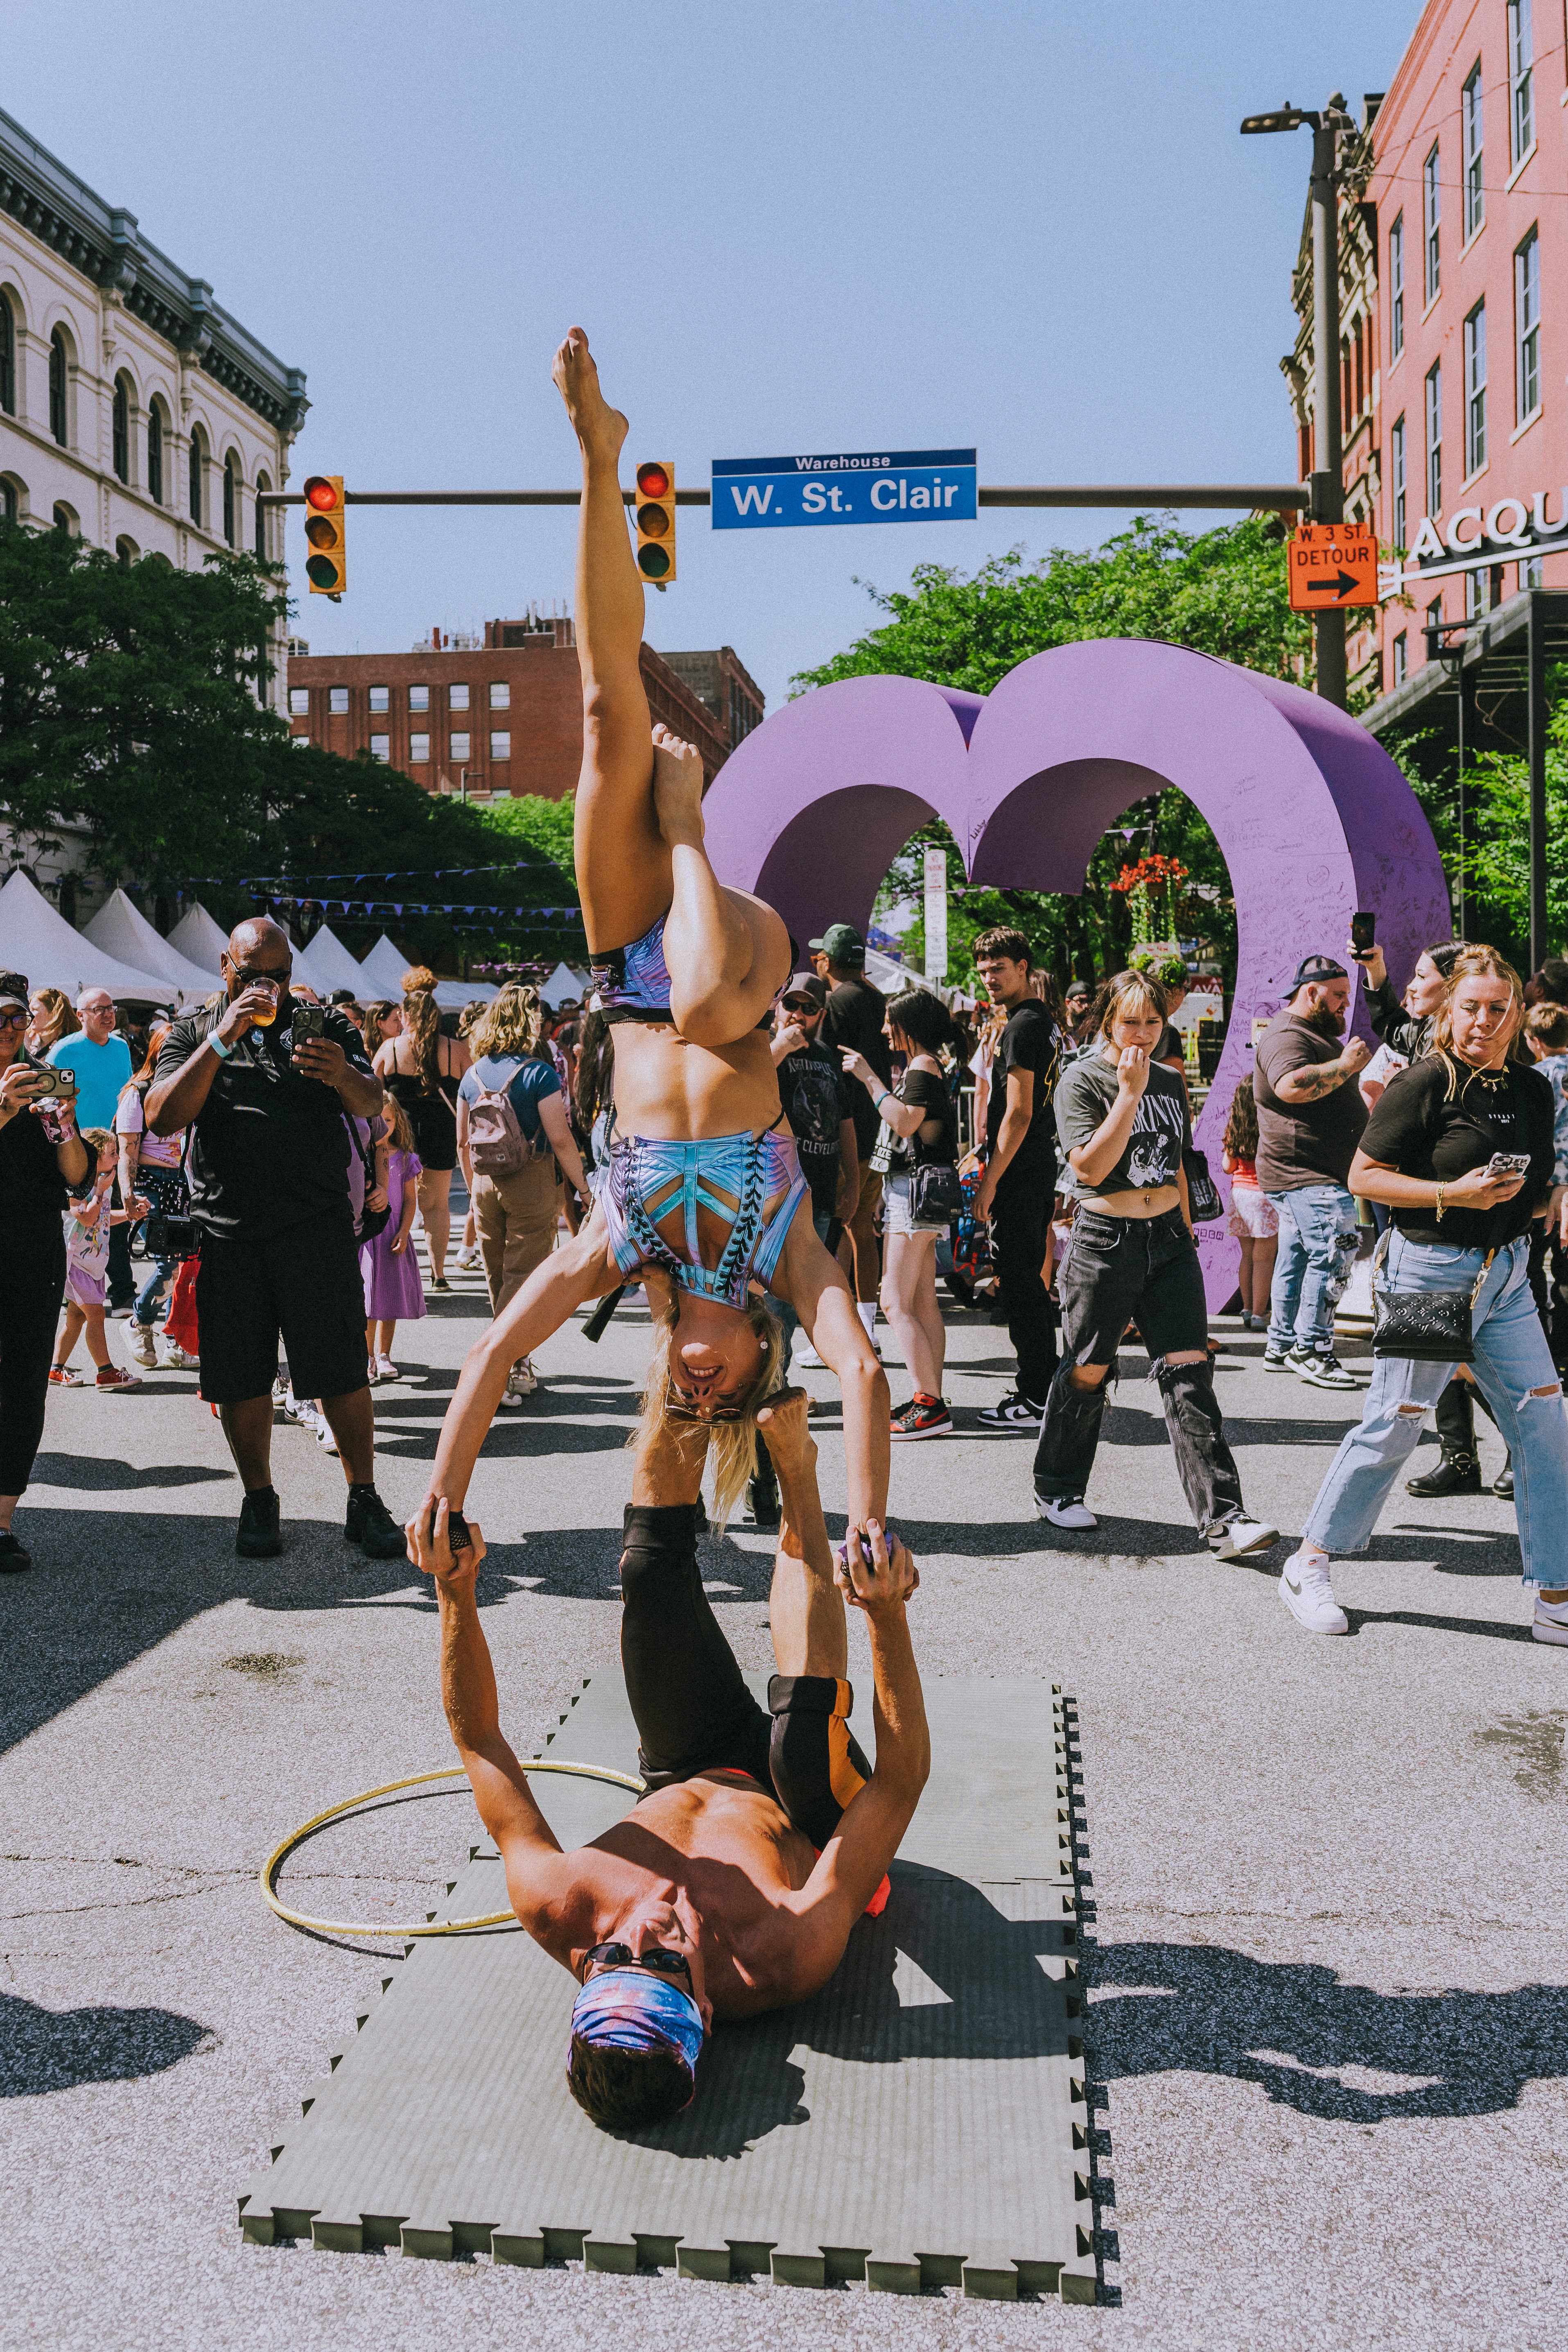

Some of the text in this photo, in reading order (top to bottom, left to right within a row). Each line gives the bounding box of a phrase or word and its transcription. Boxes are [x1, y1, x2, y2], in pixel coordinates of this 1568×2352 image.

[795, 455, 890, 470] Warehouse
[731, 477, 959, 515] W. St. Clair
[1408, 486, 1568, 563] ACQU
[1301, 529, 1315, 542] W.
[1325, 527, 1335, 541] 3
[1297, 547, 1369, 566] DETOUR
